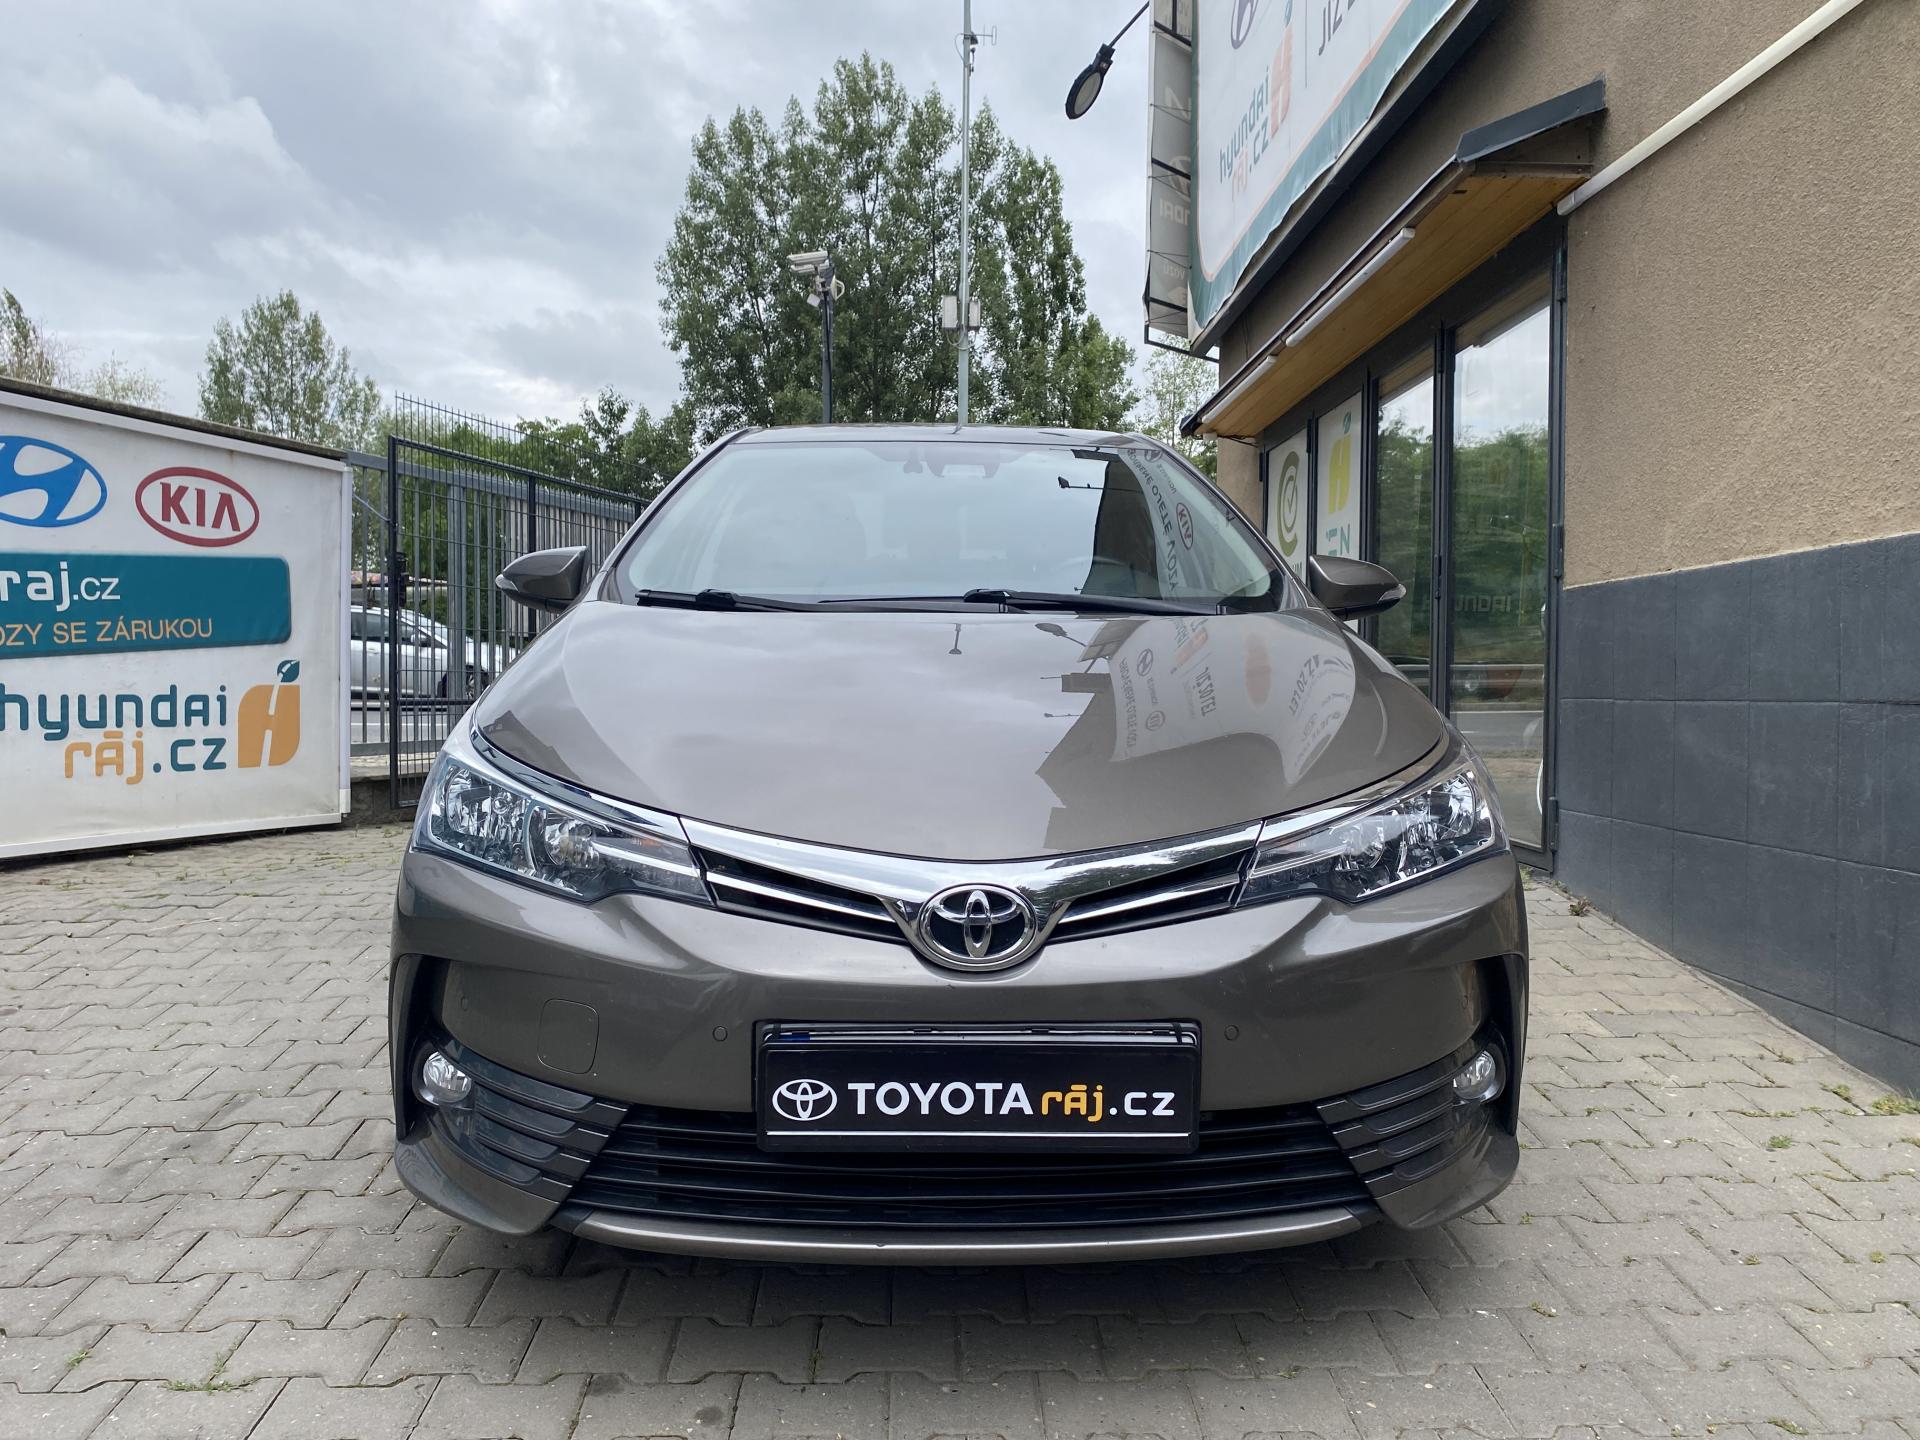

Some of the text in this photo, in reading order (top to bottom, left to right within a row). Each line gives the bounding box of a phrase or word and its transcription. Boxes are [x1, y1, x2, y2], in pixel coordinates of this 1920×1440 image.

[1219, 65, 1270, 184] hyundai
[160, 481, 242, 533] KIA
[53, 621, 88, 645] SE
[96, 615, 213, 643] ZÁRUKOU
[0, 683, 228, 741] hyundai
